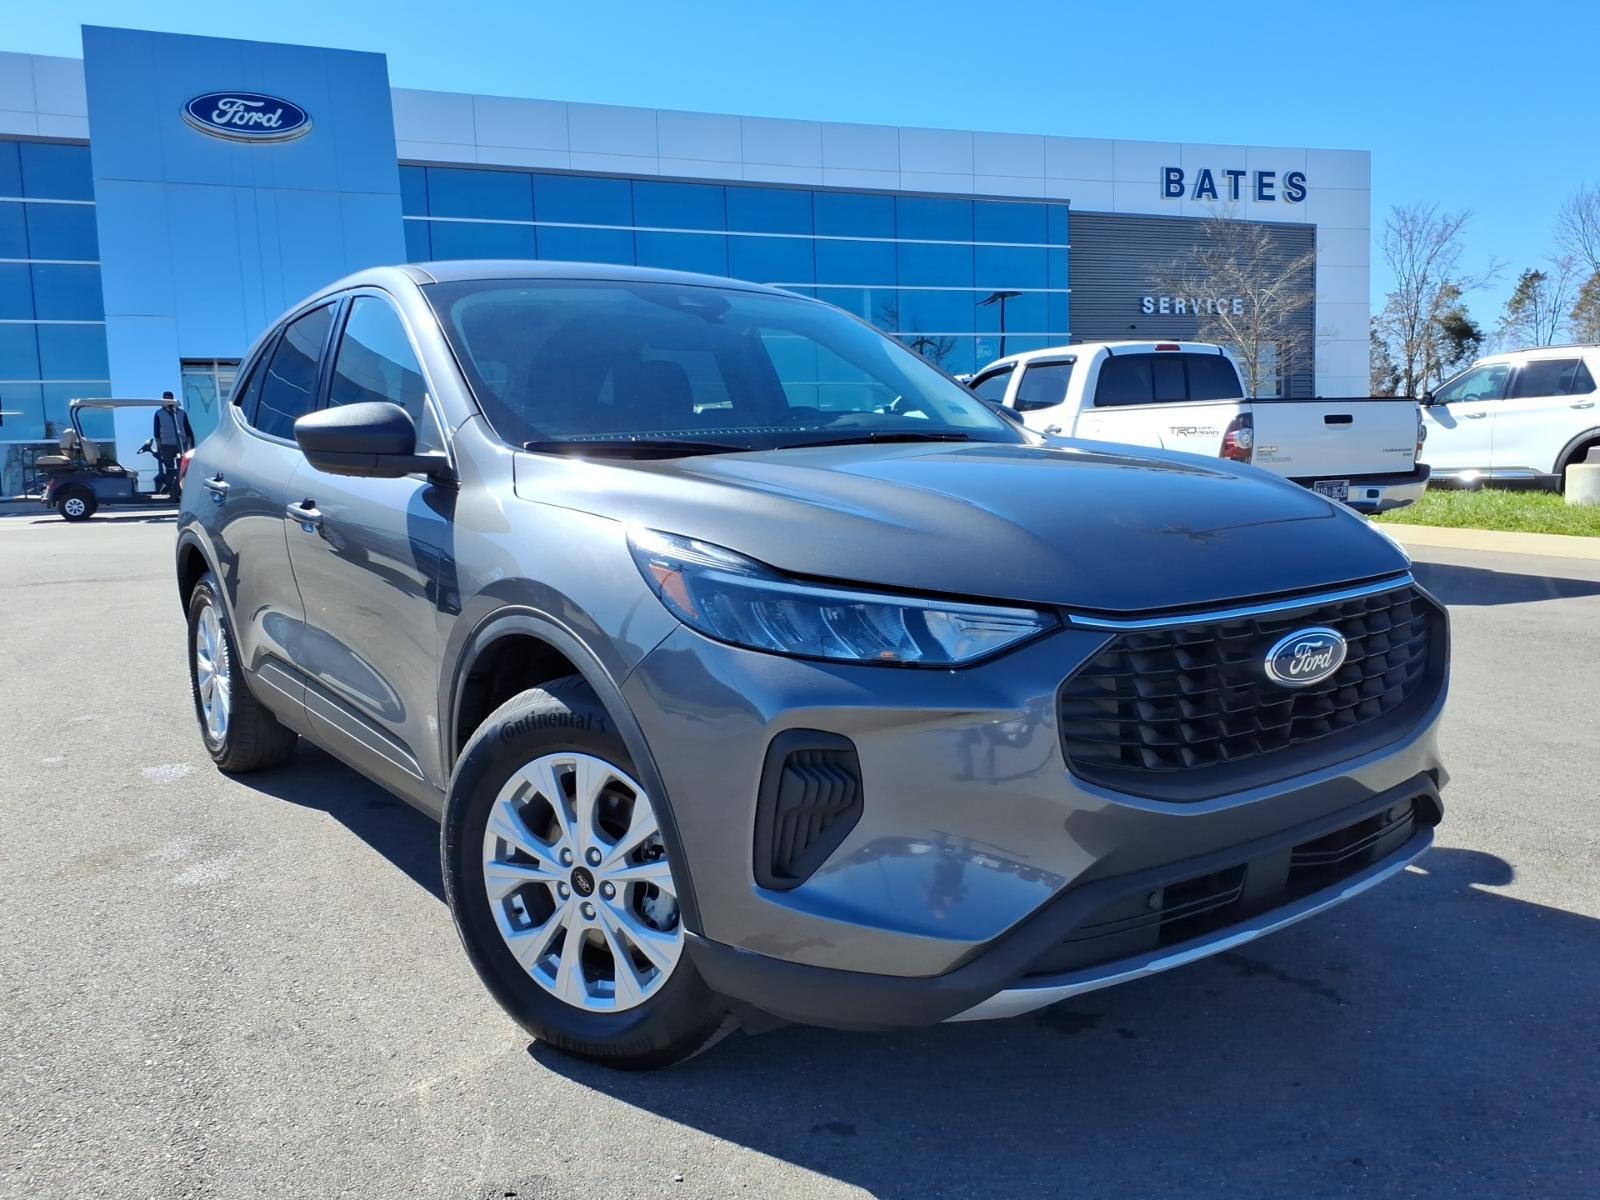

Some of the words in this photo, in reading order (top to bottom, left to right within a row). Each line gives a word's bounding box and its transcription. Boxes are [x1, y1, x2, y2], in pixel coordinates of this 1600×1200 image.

[212, 98, 283, 128] Ford
[1162, 167, 1307, 203] BATES
[1142, 296, 1244, 315] SERVICE
[1289, 640, 1334, 675] Ford
